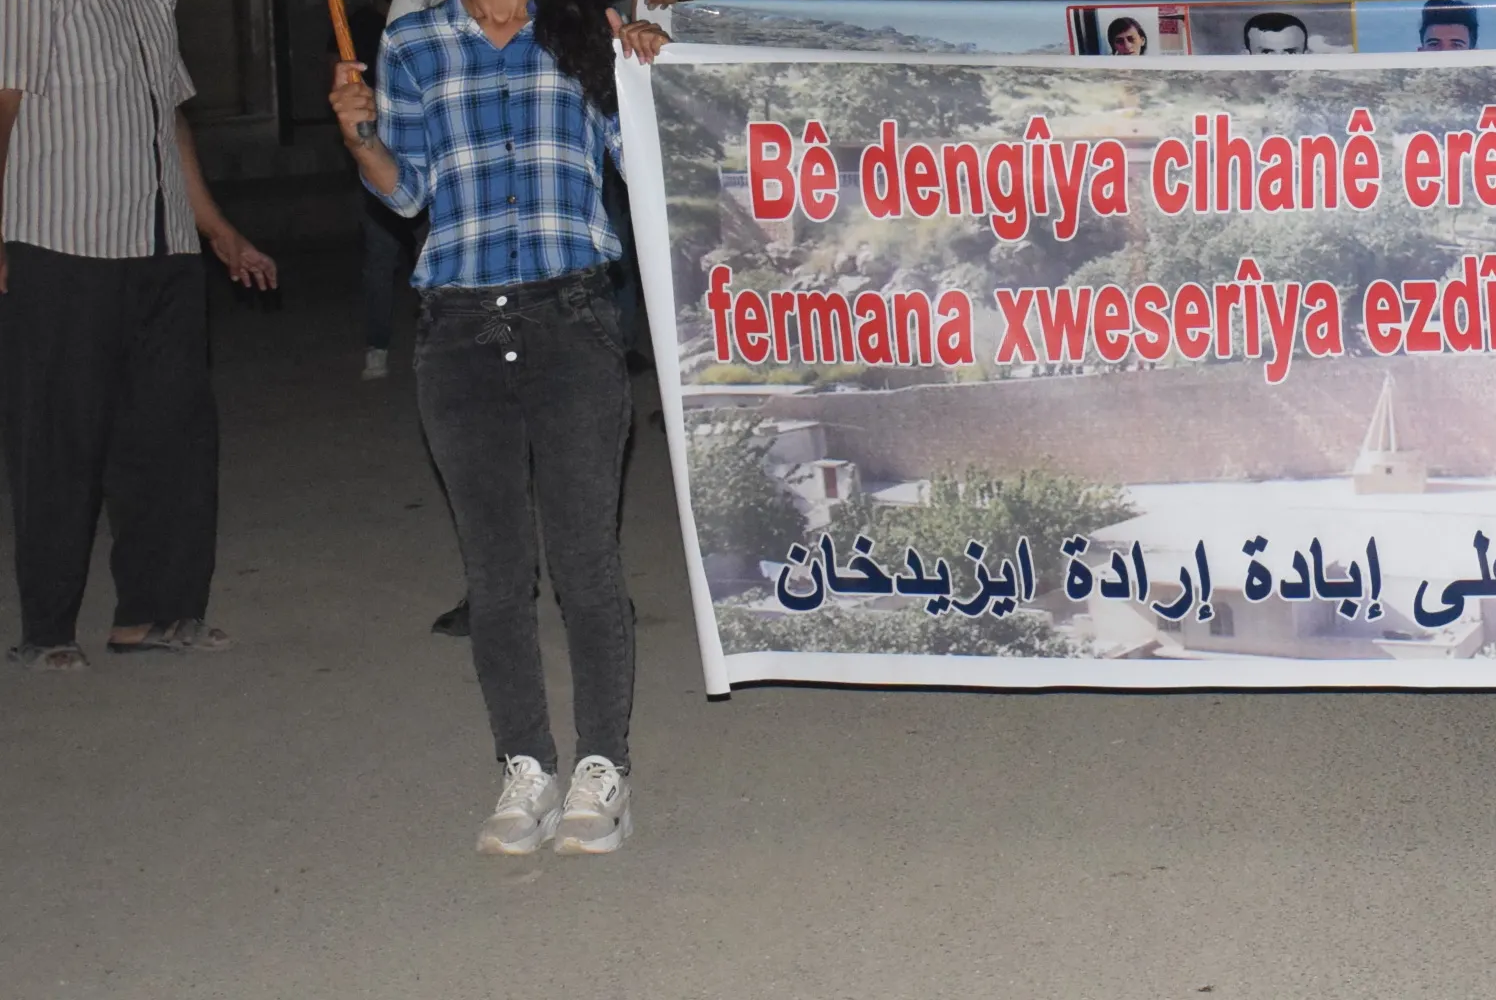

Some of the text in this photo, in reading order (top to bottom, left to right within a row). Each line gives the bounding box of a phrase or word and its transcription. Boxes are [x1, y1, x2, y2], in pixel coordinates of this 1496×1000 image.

[748, 120, 839, 222] Bê
[859, 116, 1129, 242] dengîya
[1151, 107, 1380, 216] cihanê
[706, 264, 975, 367] fermana
[995, 258, 1345, 385] xweserîya
[776, 533, 1036, 619] ايزيدخان
[1060, 534, 1213, 622] إرادة
[1243, 534, 1383, 622] إبادة
